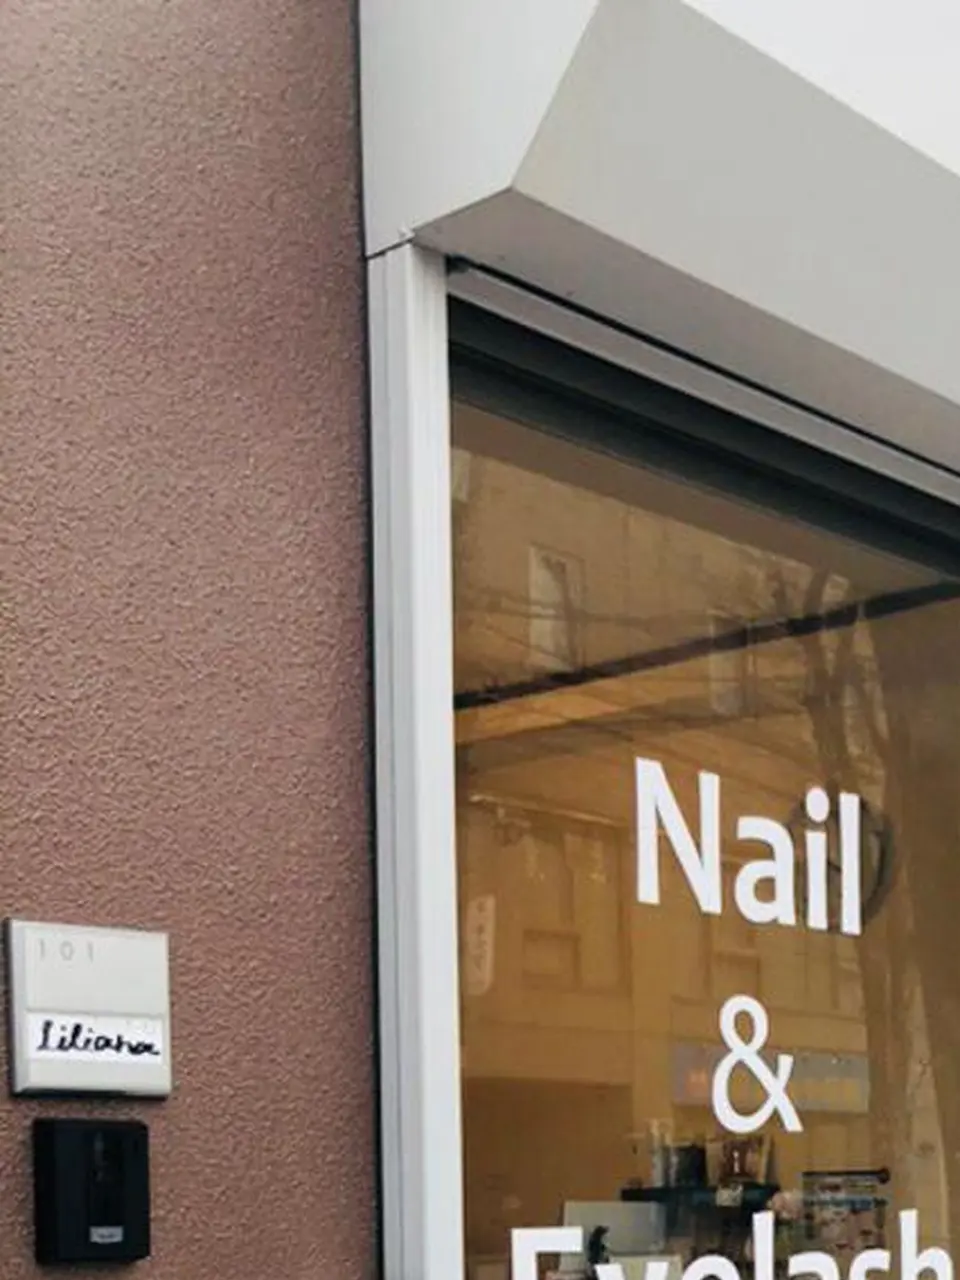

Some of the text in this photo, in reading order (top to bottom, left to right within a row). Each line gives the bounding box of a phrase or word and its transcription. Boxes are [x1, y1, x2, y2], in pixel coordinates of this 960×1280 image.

[635, 757, 863, 937] Nail
[39, 938, 97, 962] 101
[712, 994, 804, 1135] &
